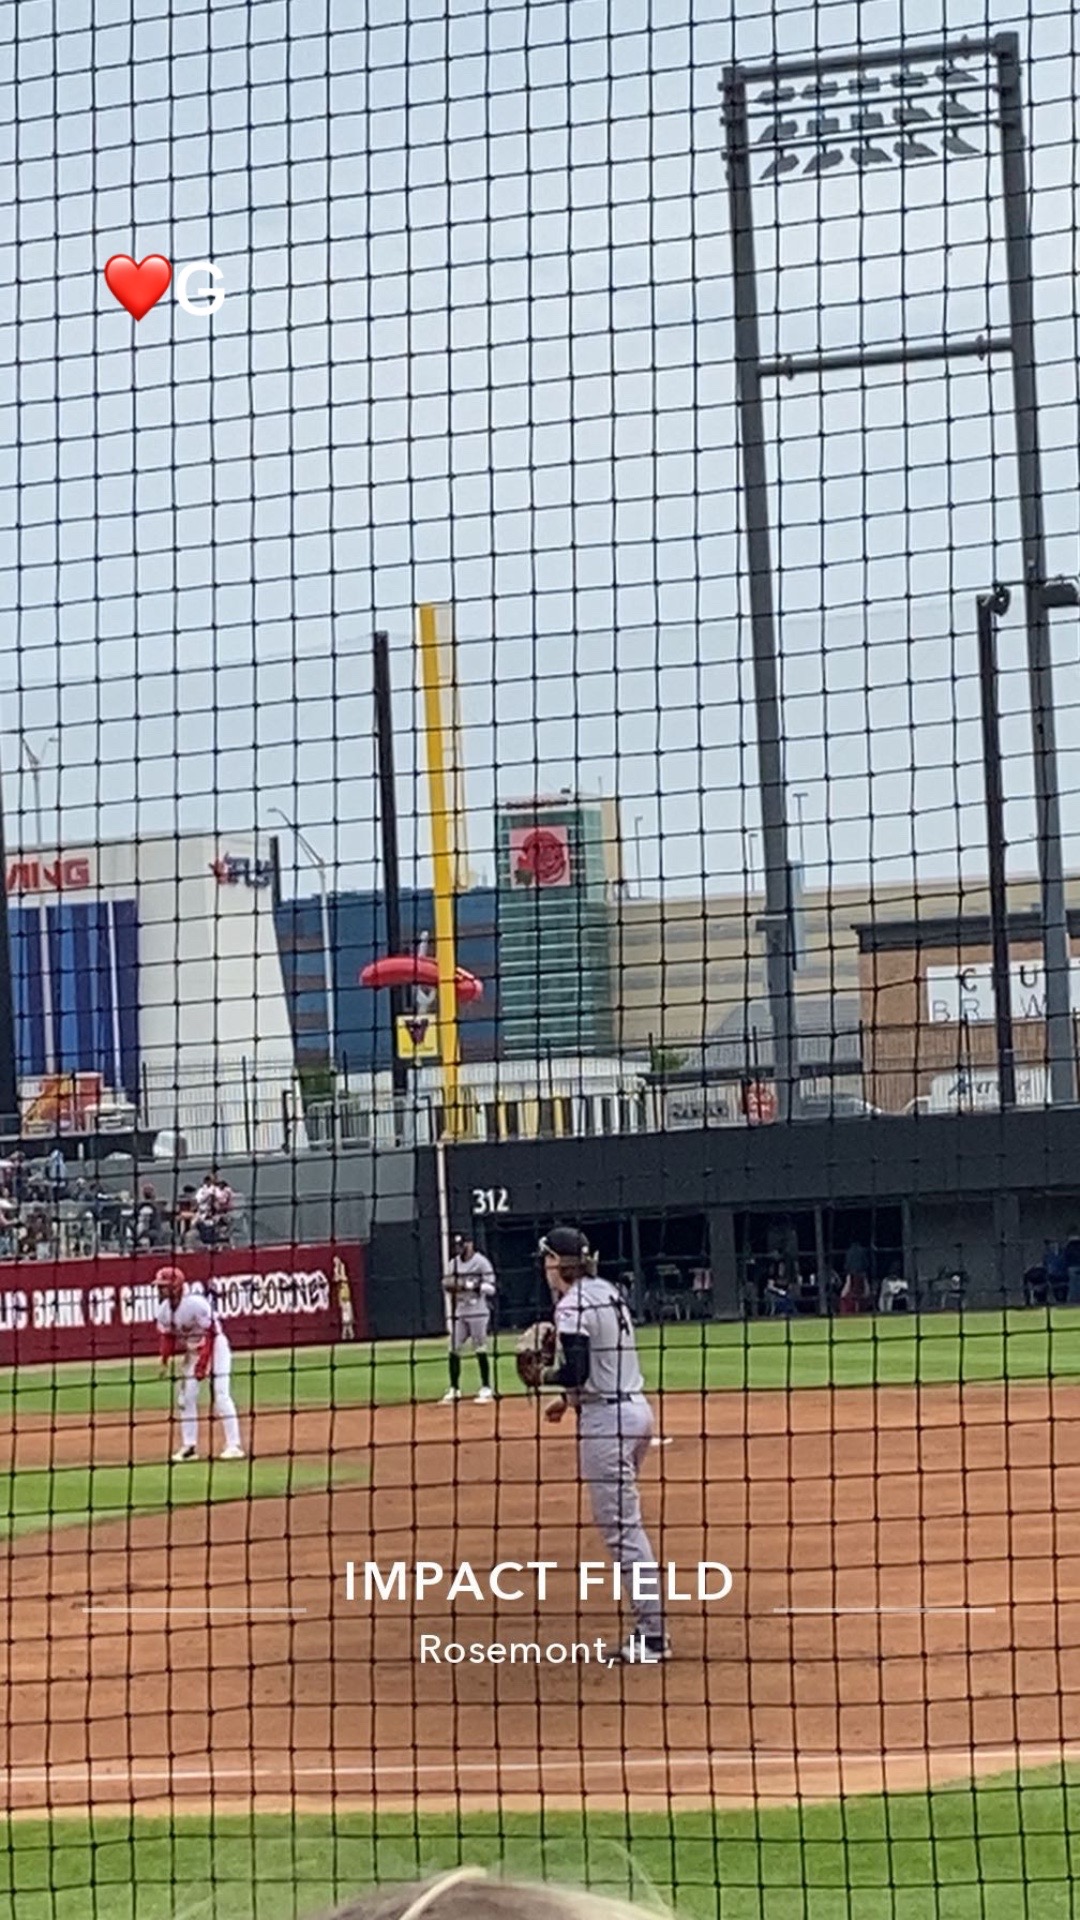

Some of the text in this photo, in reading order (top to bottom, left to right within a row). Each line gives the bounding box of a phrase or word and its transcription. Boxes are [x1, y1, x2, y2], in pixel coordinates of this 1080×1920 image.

[472, 1187, 509, 1214] 312
[32, 1288, 86, 1328] BANK
[88, 1286, 116, 1326] OF
